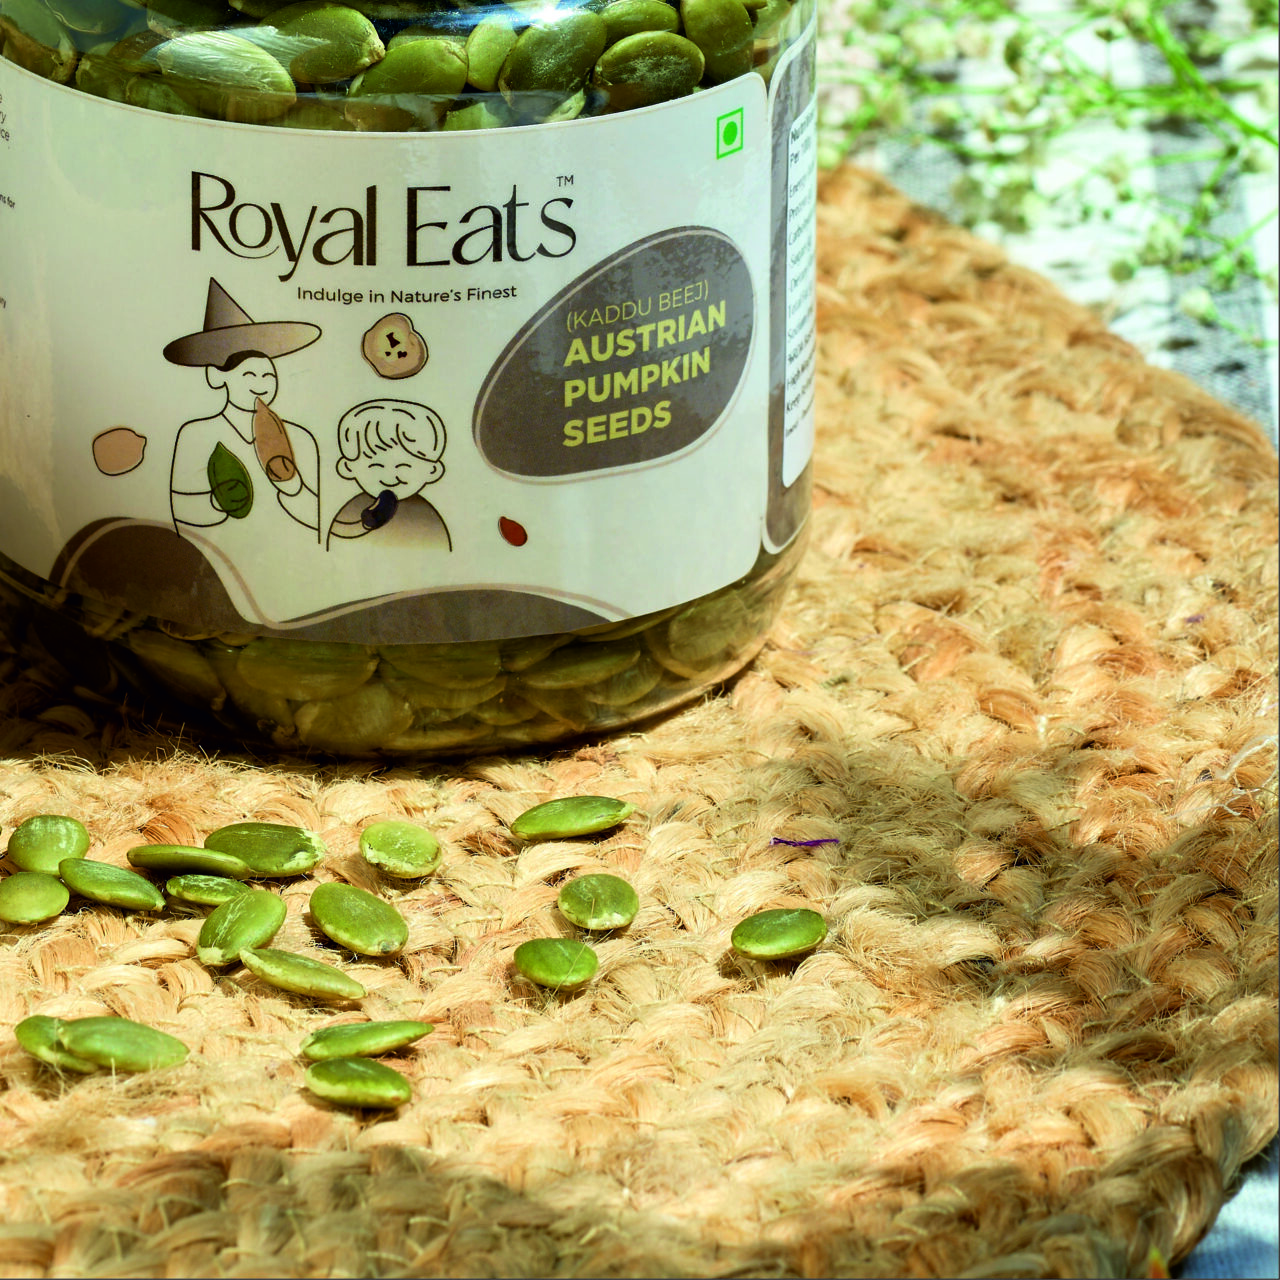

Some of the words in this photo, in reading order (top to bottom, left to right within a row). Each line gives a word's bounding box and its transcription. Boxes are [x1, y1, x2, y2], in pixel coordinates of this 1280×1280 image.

[191, 170, 377, 282] Royal
[406, 183, 577, 267] Eats
[297, 286, 364, 305] Indulge
[369, 289, 385, 303] in
[390, 289, 462, 304] Nature's
[467, 285, 518, 301] Finest
[566, 297, 652, 333] (KADDU
[658, 279, 709, 312] BEEJ)
[563, 300, 726, 367] AUSTRIAN
[564, 346, 711, 408] PUMPKIN
[562, 400, 672, 448] SEEDS
